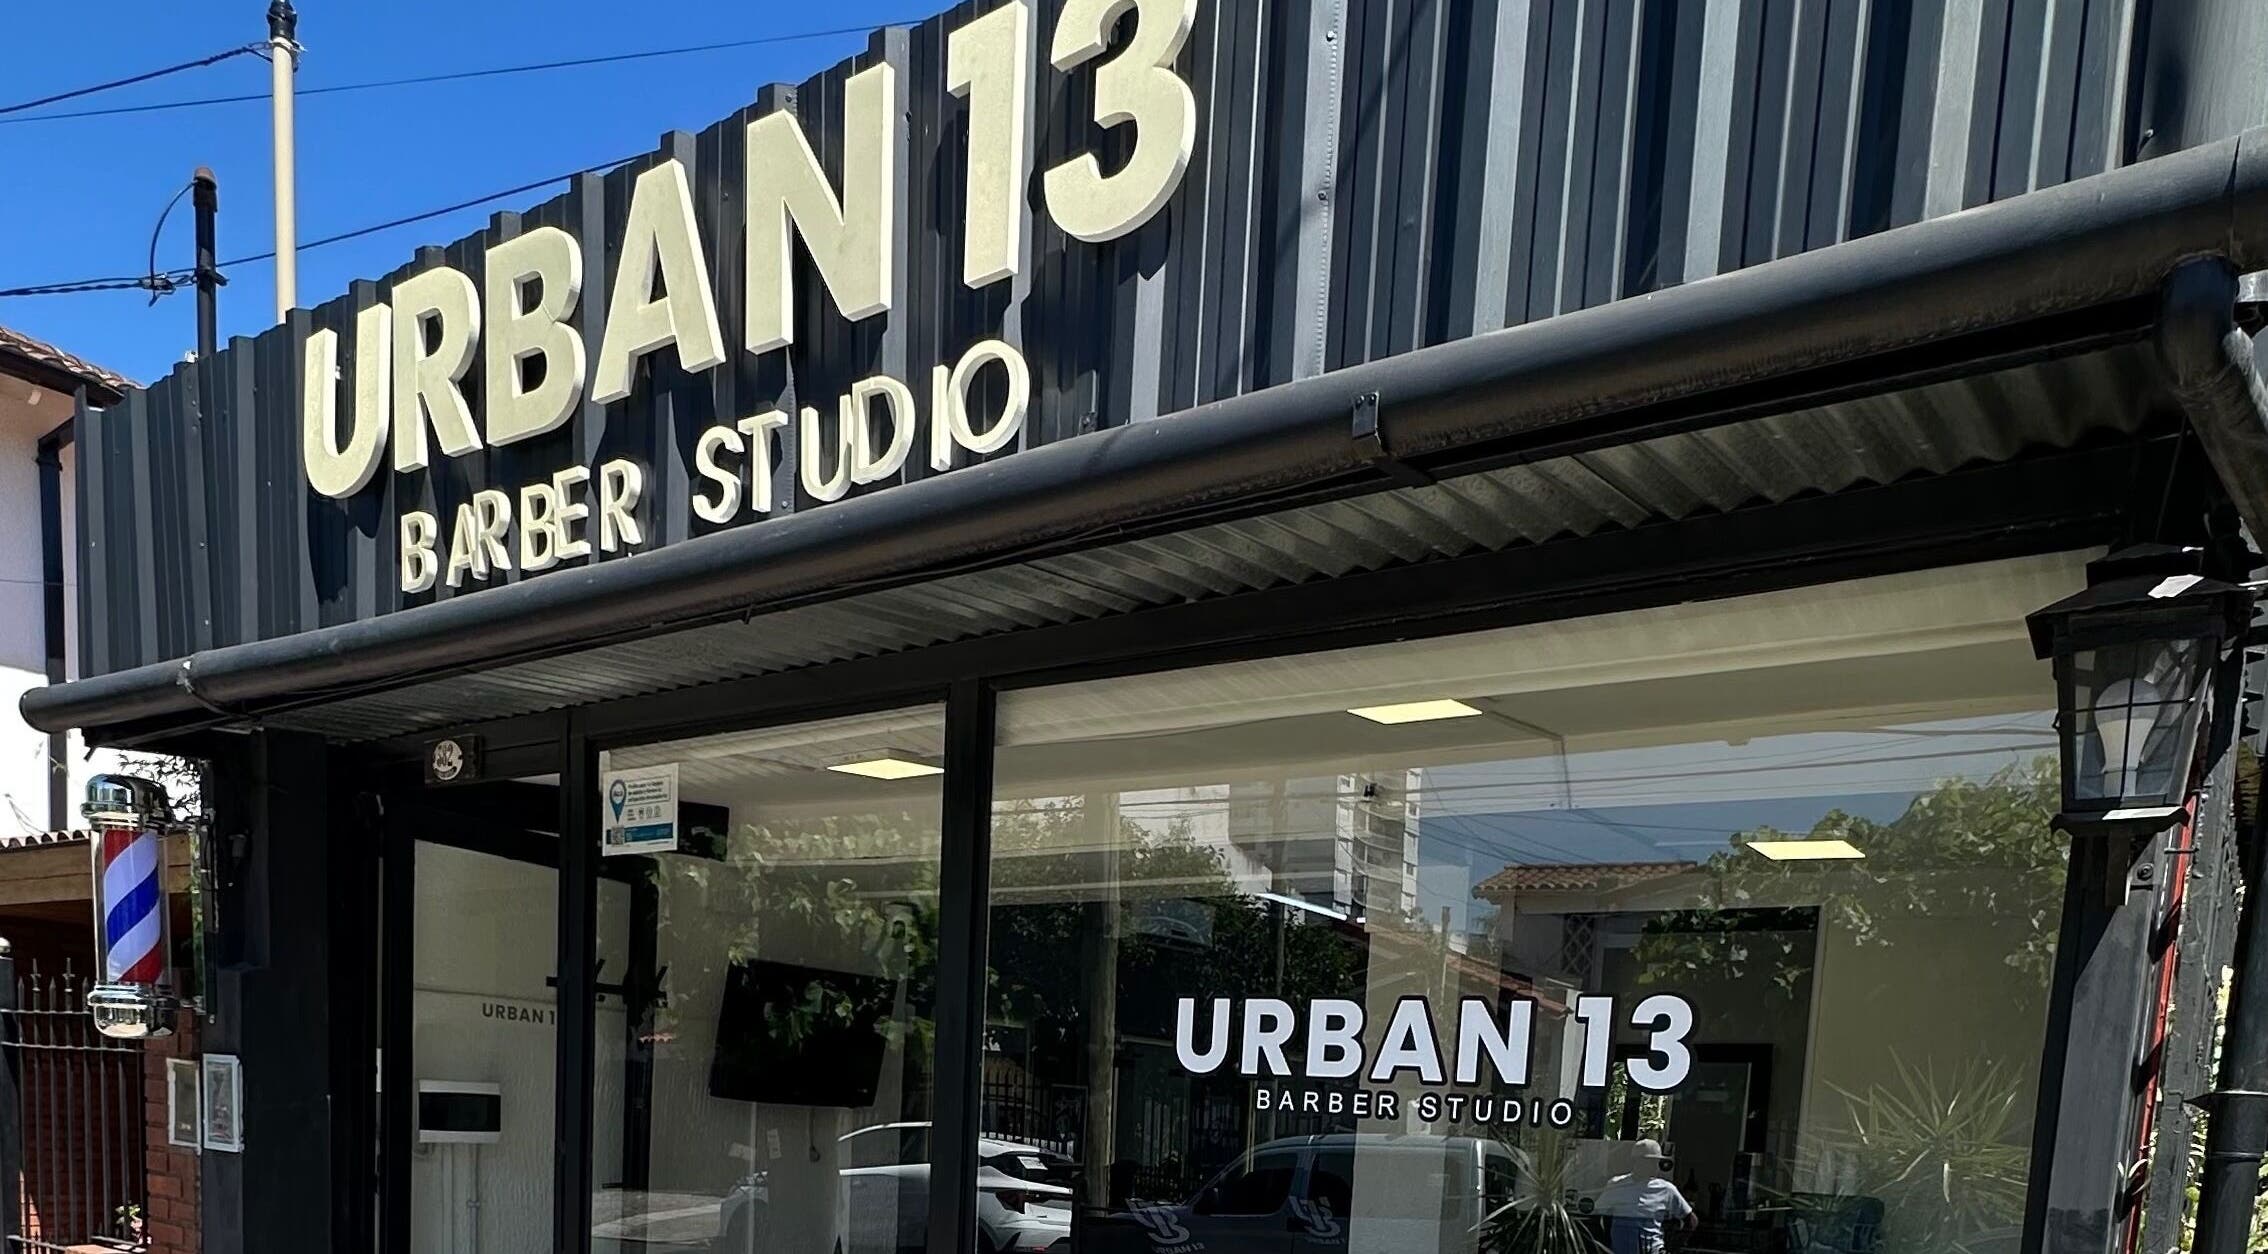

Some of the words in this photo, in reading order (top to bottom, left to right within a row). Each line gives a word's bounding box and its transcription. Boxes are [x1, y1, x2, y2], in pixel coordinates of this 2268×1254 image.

[303, 61, 896, 499] URBAN
[946, 0, 1199, 288] 13
[400, 459, 644, 593] BARBER
[692, 339, 1031, 524] STUDIO
[482, 1003, 544, 1023] URBAN
[1174, 997, 1533, 1085] URBAN
[1575, 995, 1693, 1089] 13
[1256, 1089, 1397, 1117] BARBER
[1420, 1096, 1572, 1125] STUDIO
